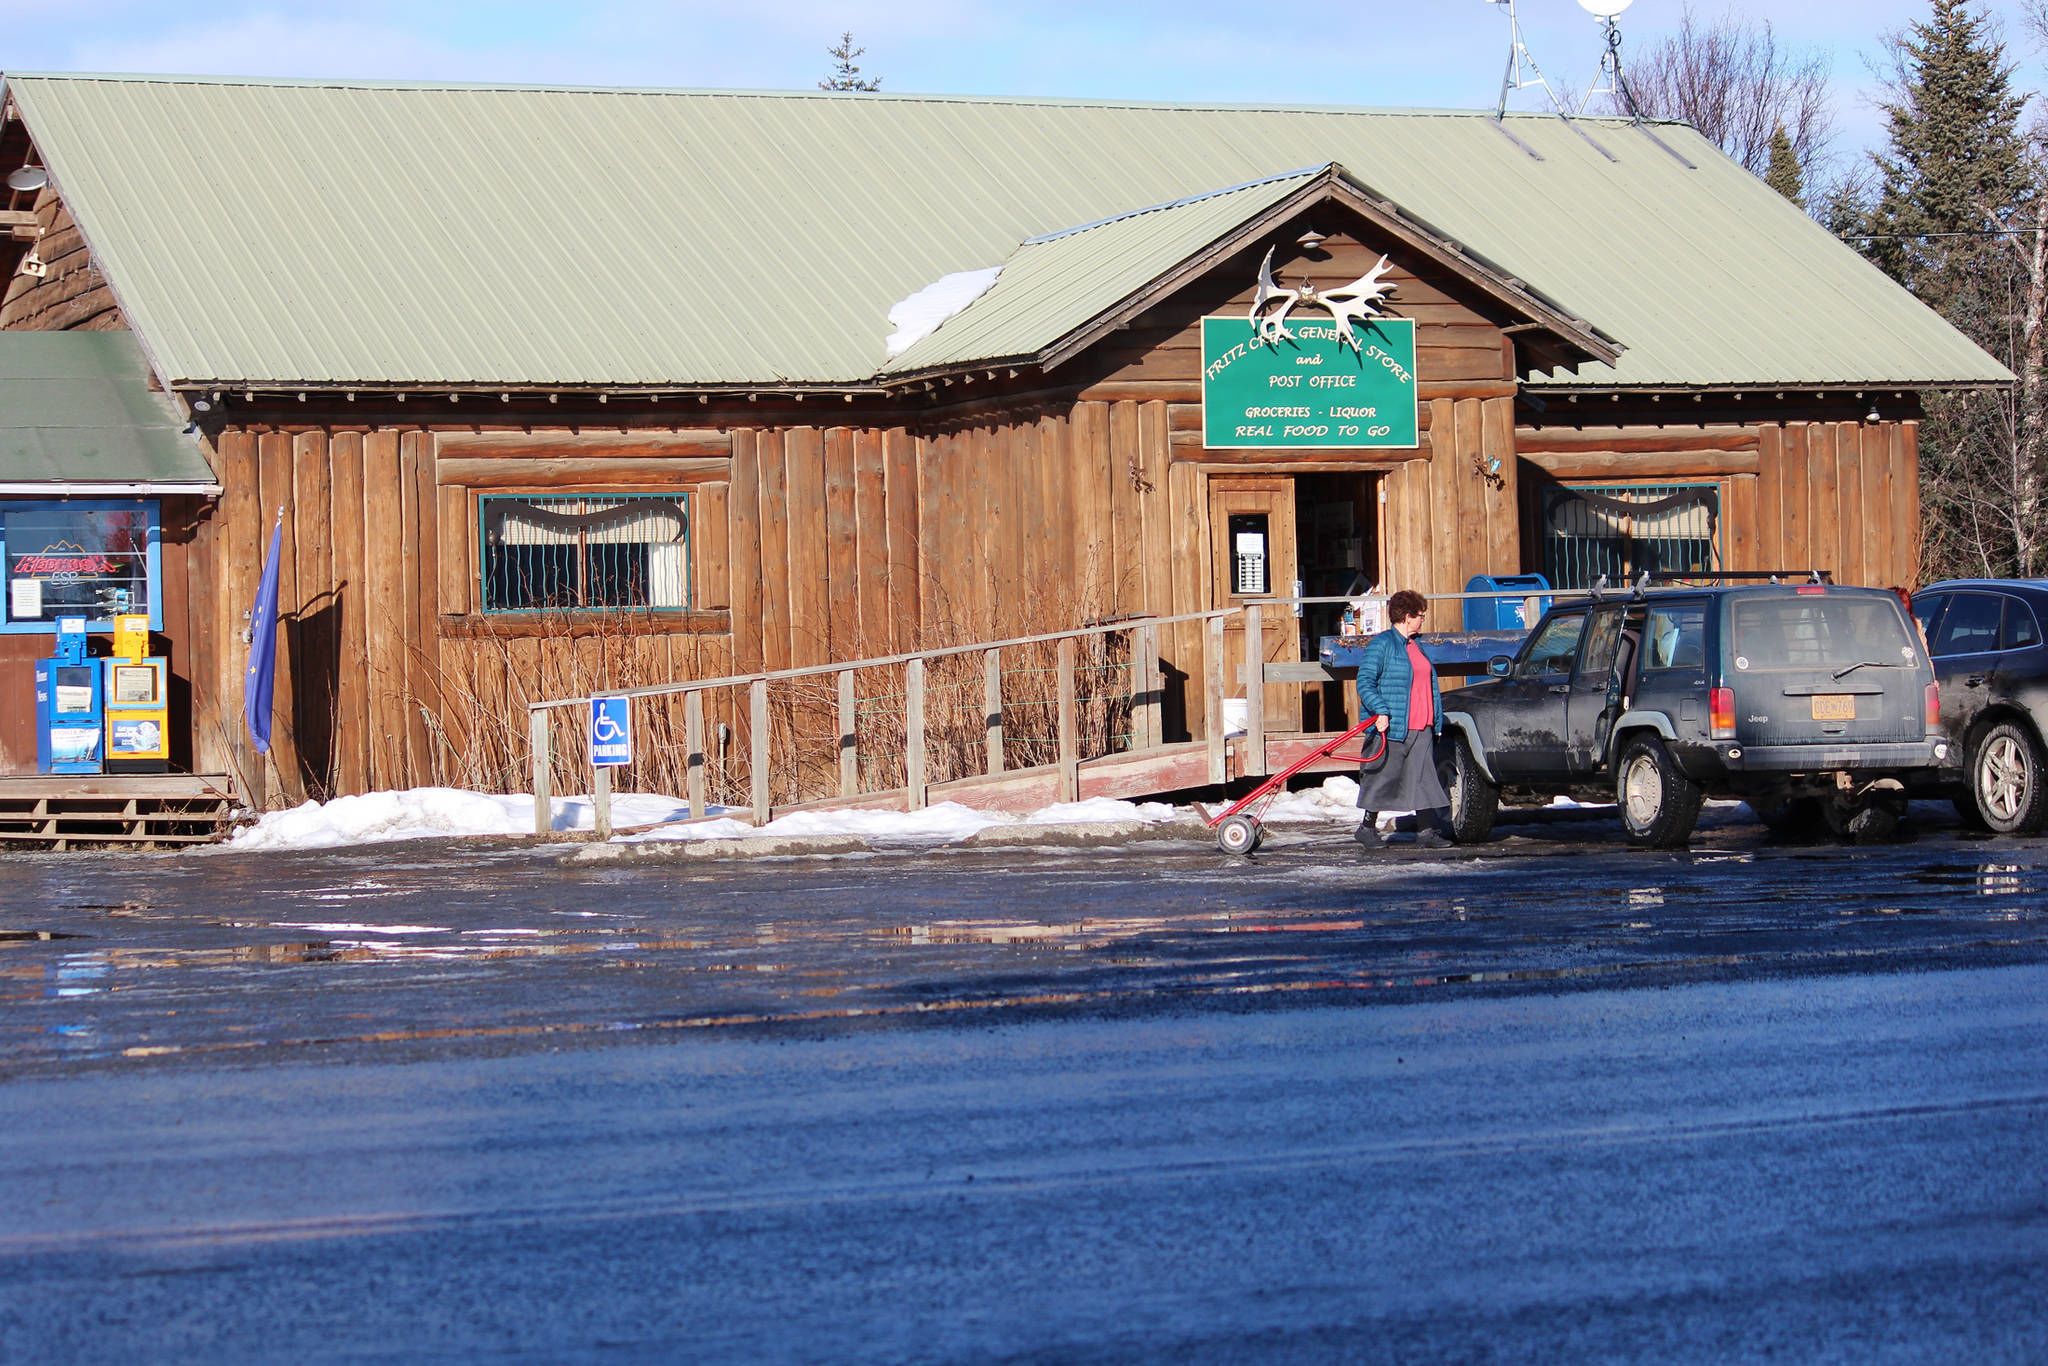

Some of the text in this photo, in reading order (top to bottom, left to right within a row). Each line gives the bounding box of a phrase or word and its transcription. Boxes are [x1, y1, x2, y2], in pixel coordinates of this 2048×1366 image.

[1206, 343, 1247, 381] FRITZ
[1298, 326, 1363, 351] GENEL
[1366, 345, 1412, 384] STORE
[1296, 354, 1323, 365] and
[1269, 375, 1356, 388] POST OFFICE
[1245, 407, 1310, 419] GROCERIES
[1330, 407, 1376, 419] LIQUOR
[1235, 425, 1390, 437] REAL FOOD TO GO
[1748, 714, 1769, 723] Jeep
[593, 744, 627, 756] PARKING
